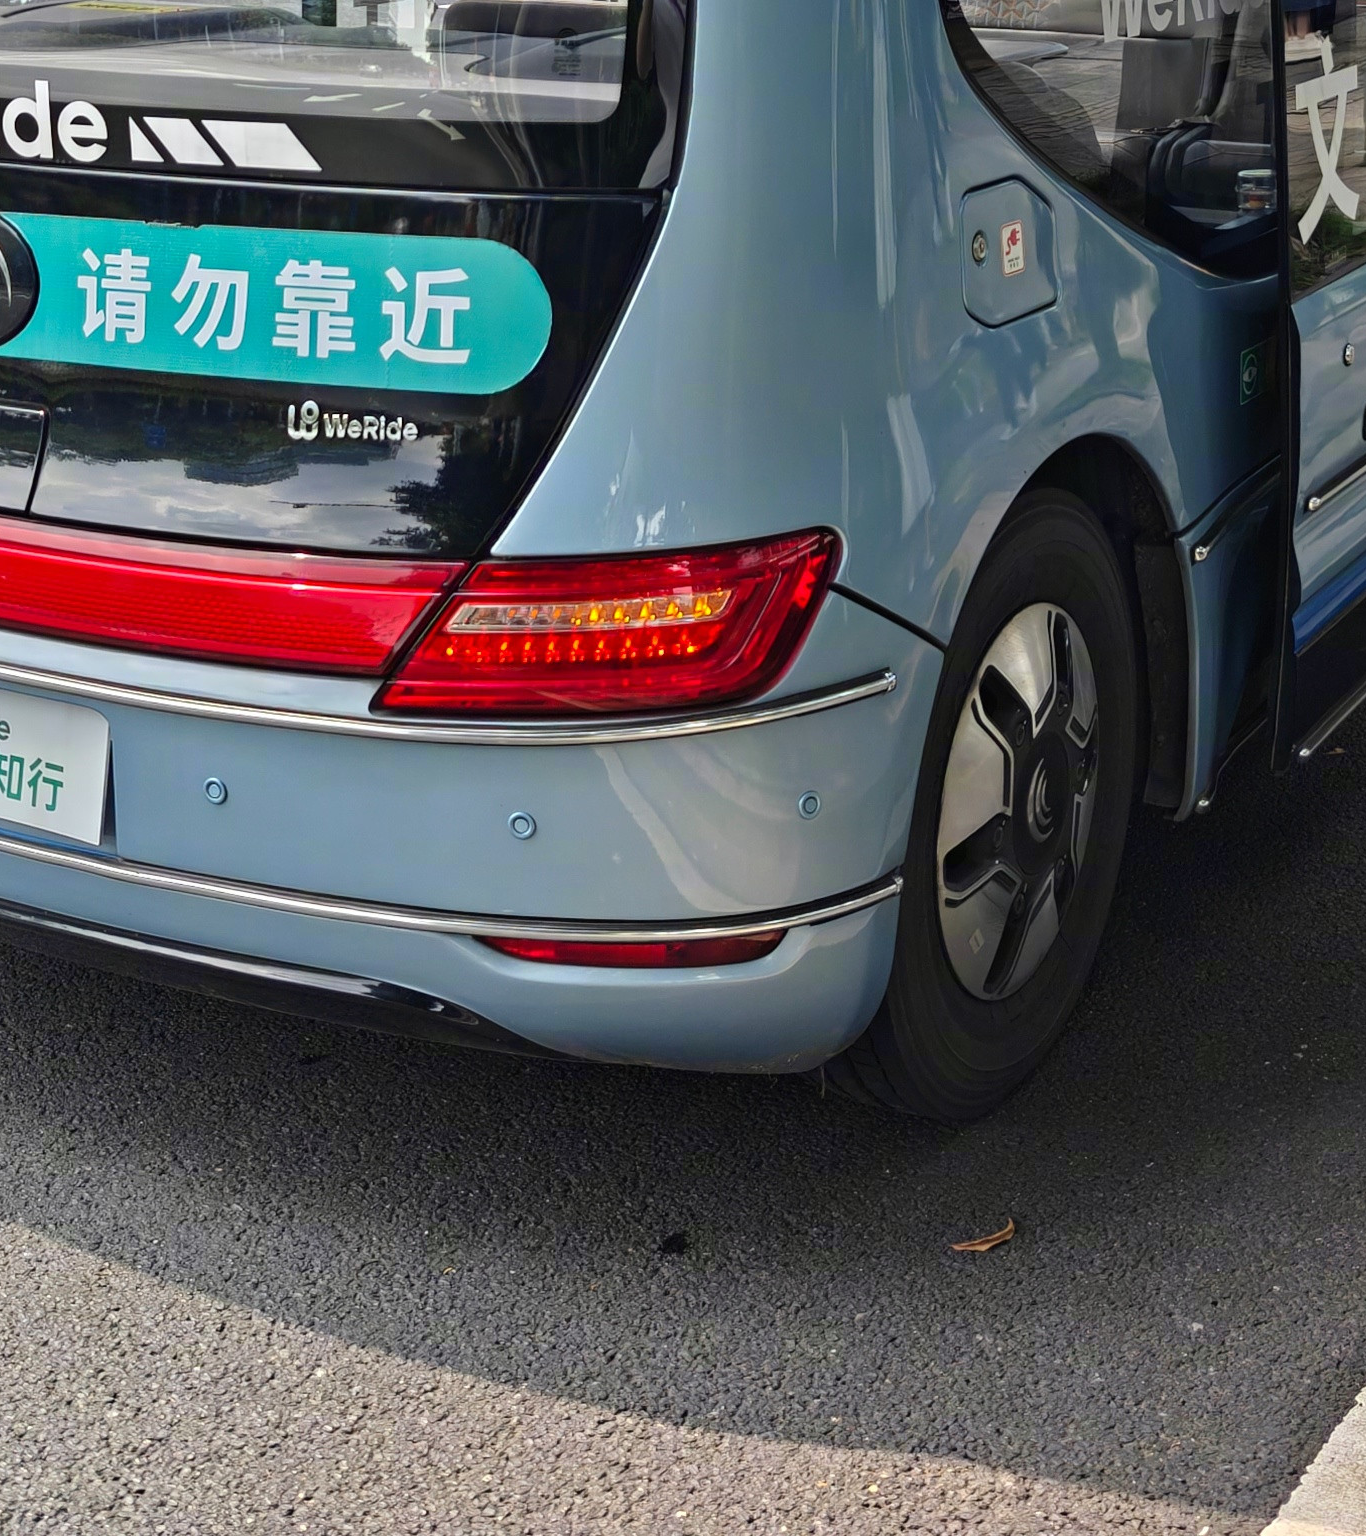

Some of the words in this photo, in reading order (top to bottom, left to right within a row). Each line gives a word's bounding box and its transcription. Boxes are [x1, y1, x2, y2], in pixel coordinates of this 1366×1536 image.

[76, 247, 472, 365] 请勿靠近
[323, 413, 419, 441] WeRide
